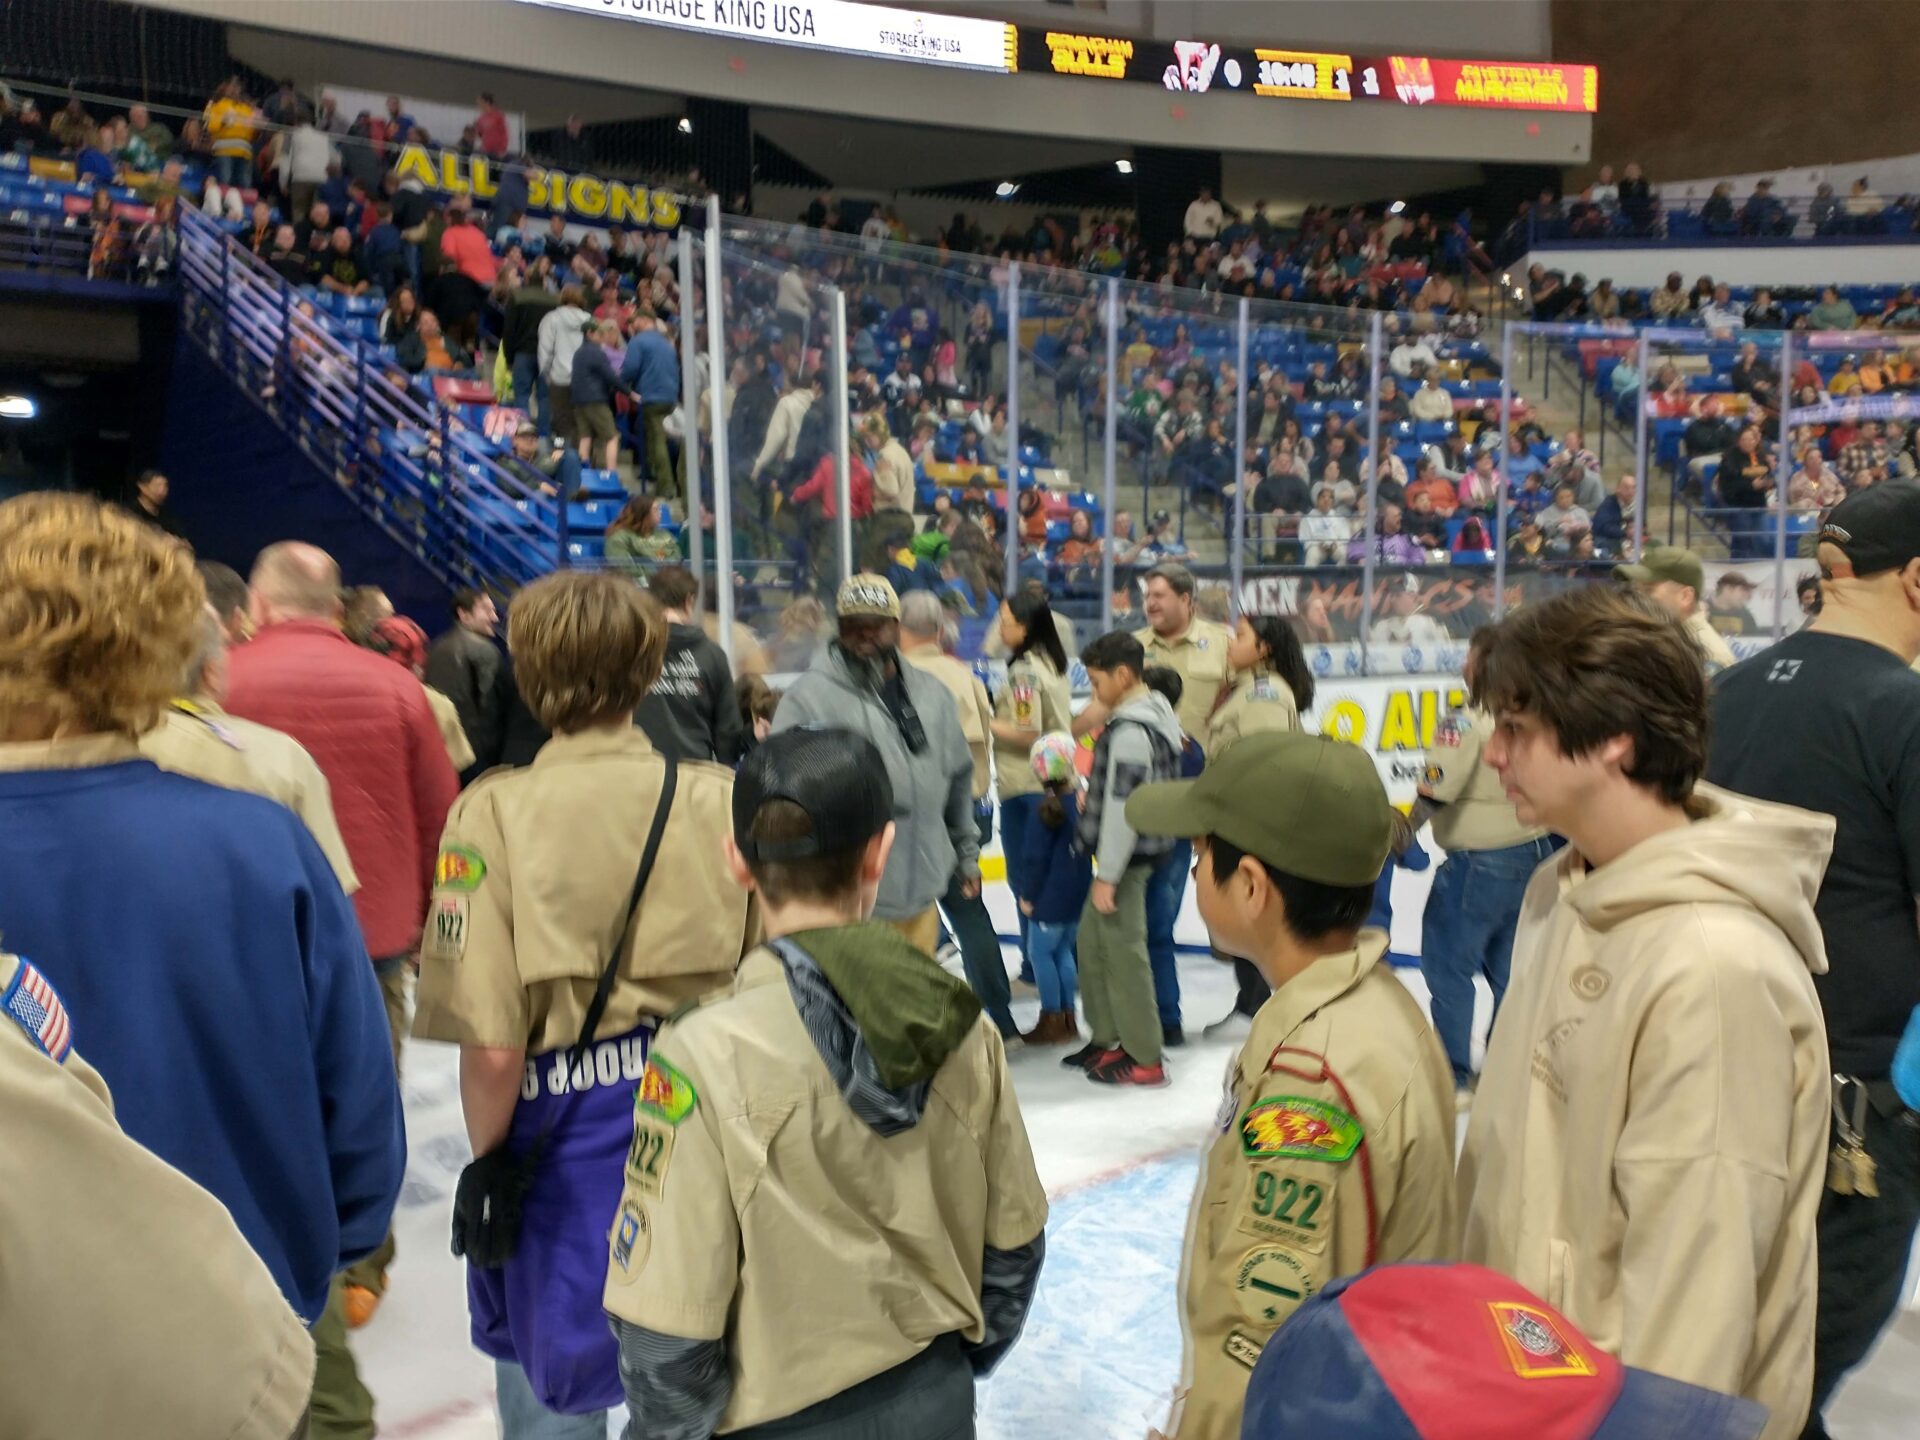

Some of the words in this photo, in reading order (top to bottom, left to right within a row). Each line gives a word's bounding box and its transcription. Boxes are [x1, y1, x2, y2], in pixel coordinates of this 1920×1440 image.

[603, 0, 706, 21] RAGE
[714, 0, 765, 30] KING
[774, 4, 816, 37] USA
[879, 30, 918, 48] STORAGE
[944, 39, 961, 53] USA
[394, 143, 498, 199] ALL
[527, 166, 682, 231] SIGNS
[1378, 689, 1465, 751] AI
[547, 1032, 652, 1096] ROOP
[1252, 1170, 1324, 1231] 922
